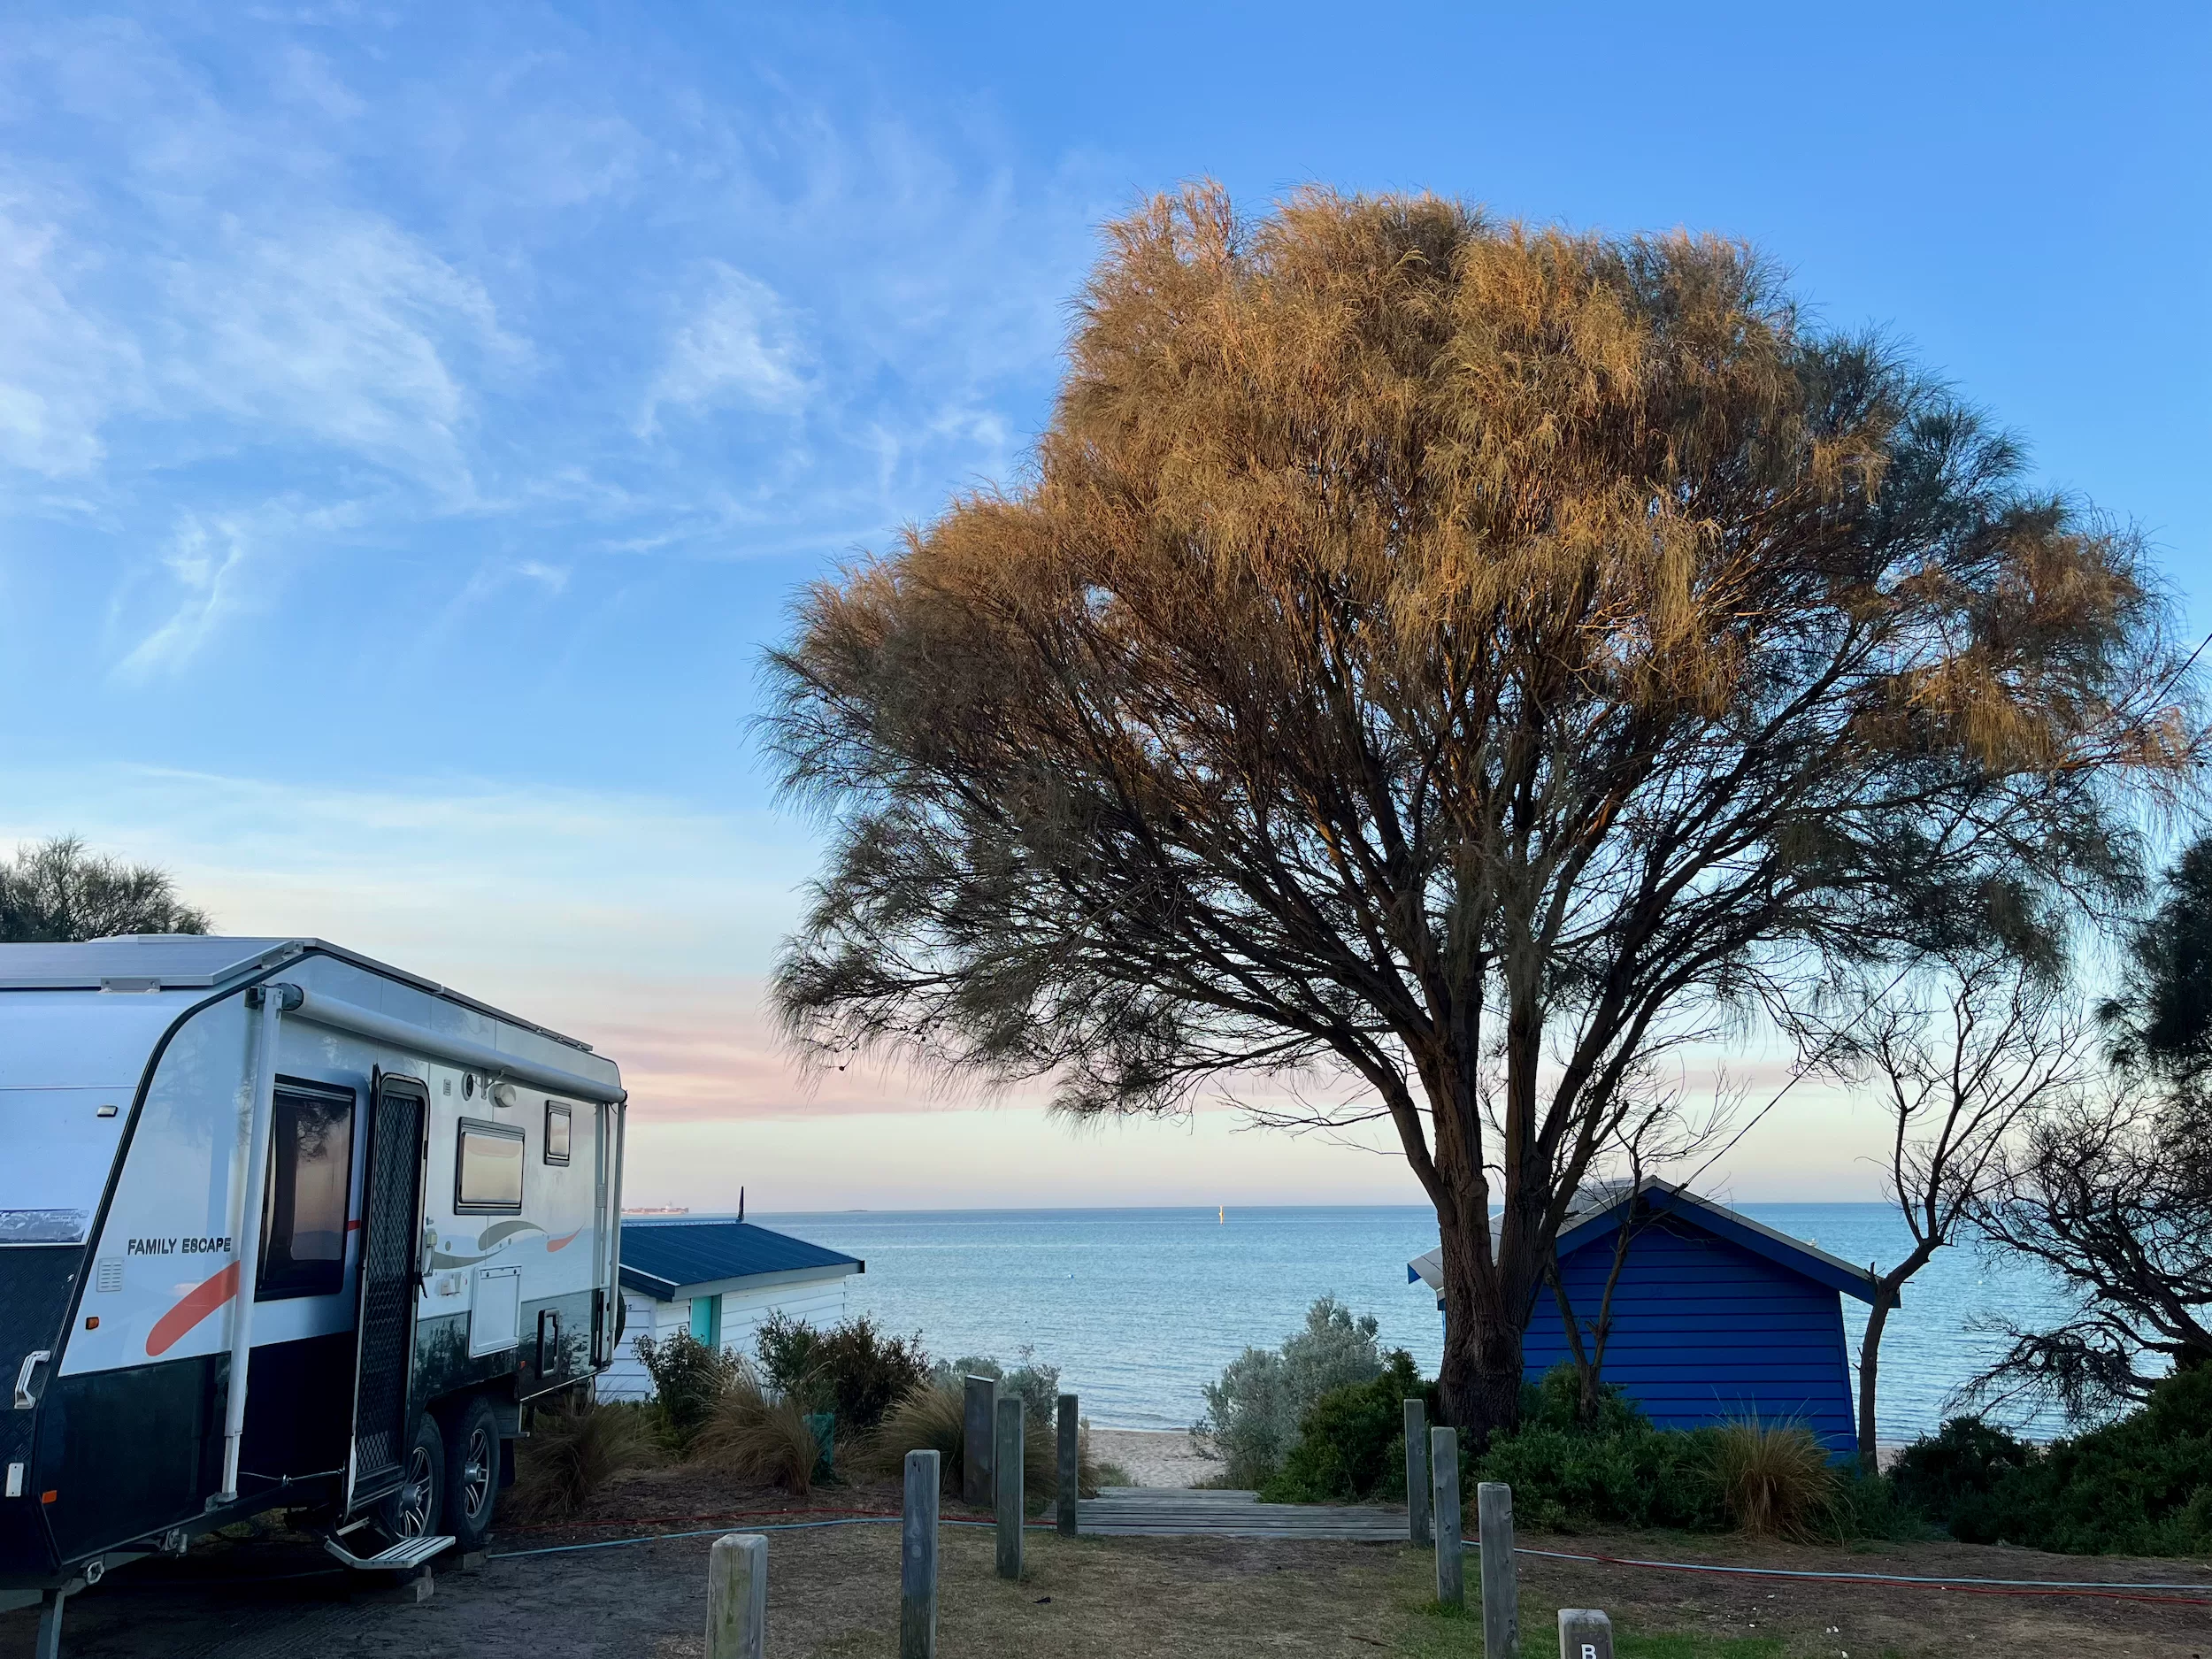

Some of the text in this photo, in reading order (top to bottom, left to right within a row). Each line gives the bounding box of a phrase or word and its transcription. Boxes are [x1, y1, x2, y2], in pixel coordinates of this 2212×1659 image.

[127, 1237, 232, 1256] FAMILY ESCAPE
[1581, 1644, 1597, 1659] B
